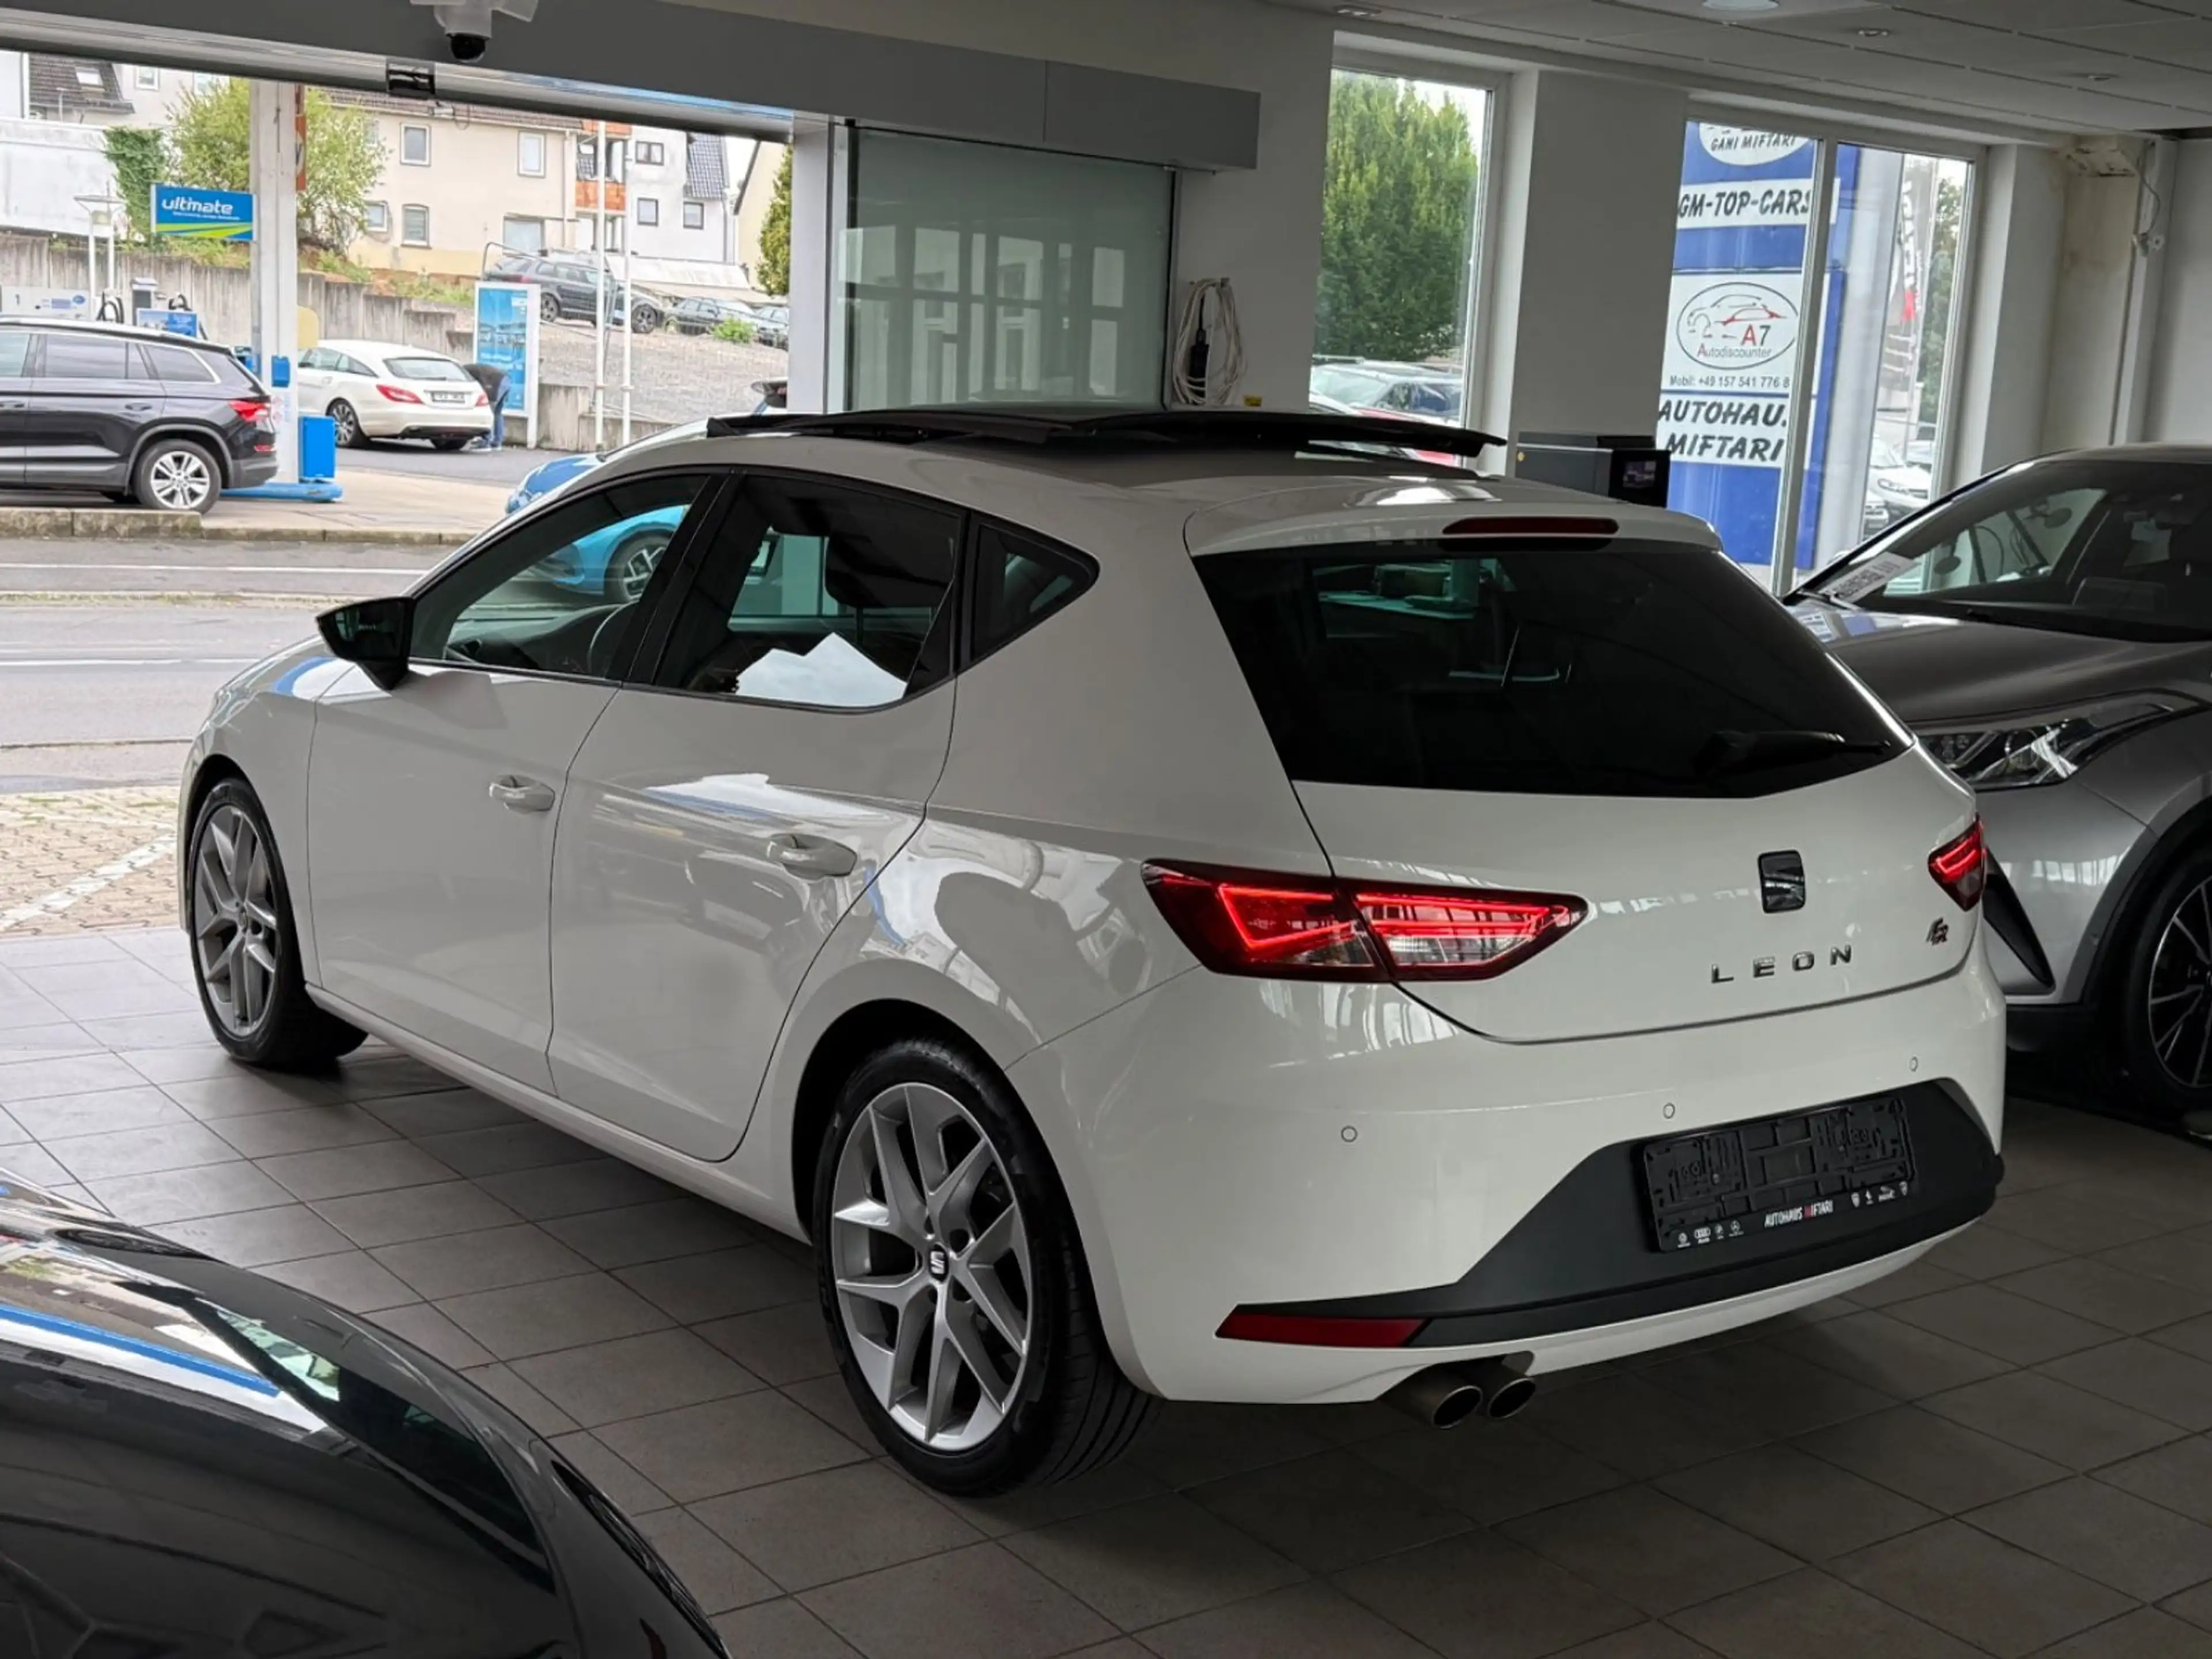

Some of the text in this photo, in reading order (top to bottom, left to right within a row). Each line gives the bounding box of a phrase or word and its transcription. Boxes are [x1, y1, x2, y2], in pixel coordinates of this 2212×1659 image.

[1711, 138, 1738, 151] GANI
[161, 196, 233, 215] ultimate
[1740, 324, 1771, 346] A7
[1697, 343, 1772, 358] Autodiscounter
[1699, 376, 1716, 388] +49
[1718, 376, 1736, 388] 157
[1738, 376, 1757, 388] 541
[1657, 399, 1786, 427] AUTOHAU
[1665, 433, 1785, 462] MIFTARI
[1711, 944, 1852, 983] LEON
